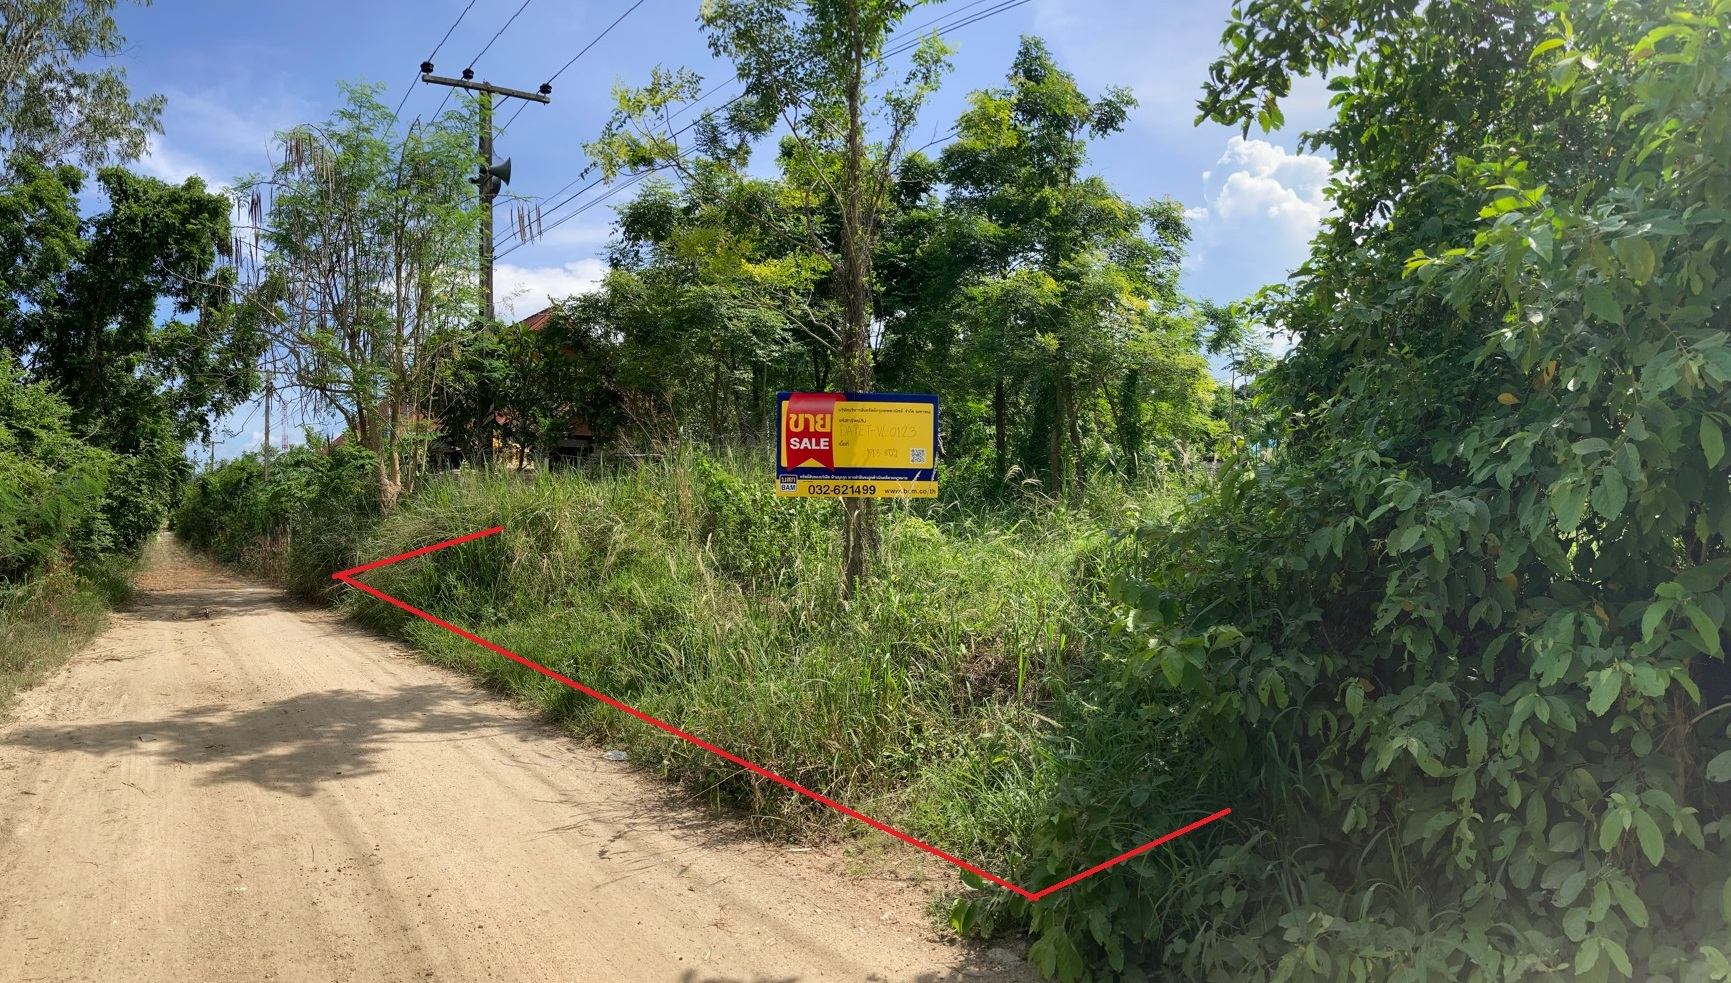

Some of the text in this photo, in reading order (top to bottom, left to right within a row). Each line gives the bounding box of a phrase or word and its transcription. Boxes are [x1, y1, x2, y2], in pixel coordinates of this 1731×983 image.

[789, 413, 831, 432] ขาย
[790, 437, 829, 449] SALE
[808, 484, 876, 495] 032-621499
